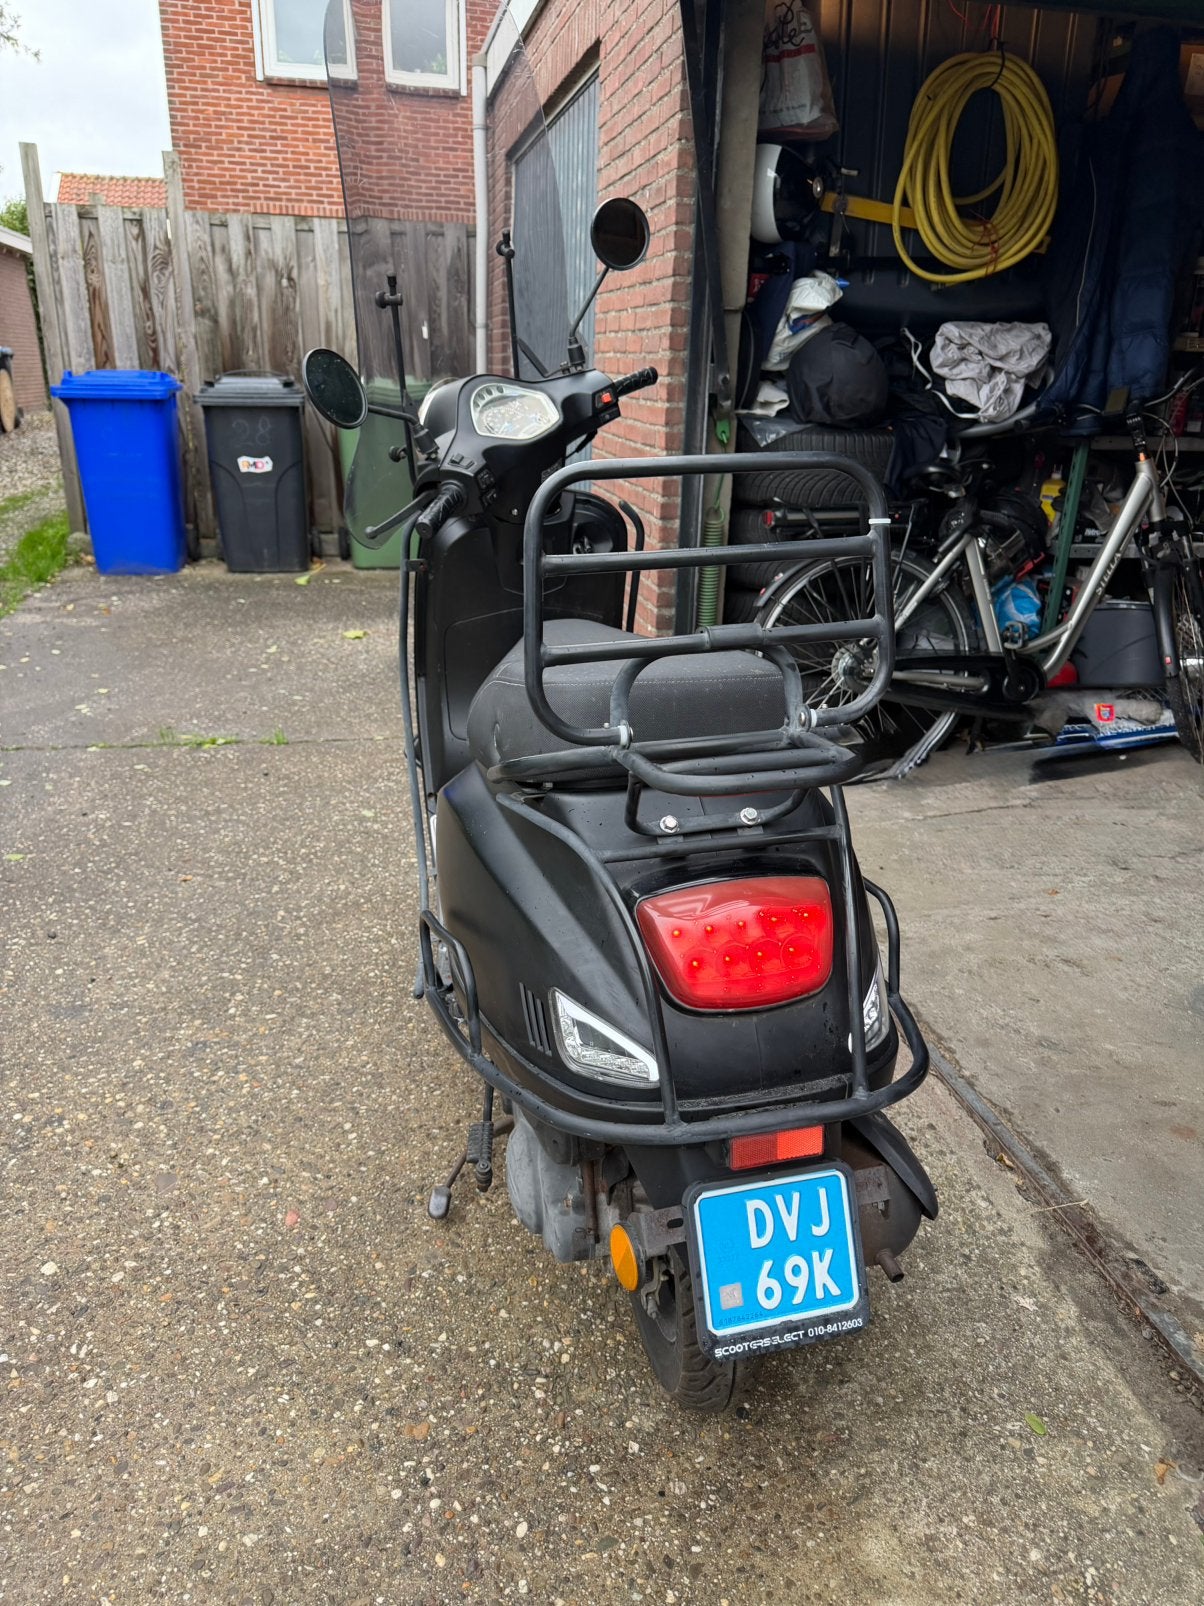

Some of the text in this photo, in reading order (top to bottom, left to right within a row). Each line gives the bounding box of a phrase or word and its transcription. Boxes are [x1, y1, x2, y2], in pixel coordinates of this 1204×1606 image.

[230, 415, 272, 448] 28
[744, 1187, 831, 1250] DVJ
[756, 1248, 842, 1311] 69K
[714, 1317, 864, 1358] SCOOTERSELECT 010-8412603
